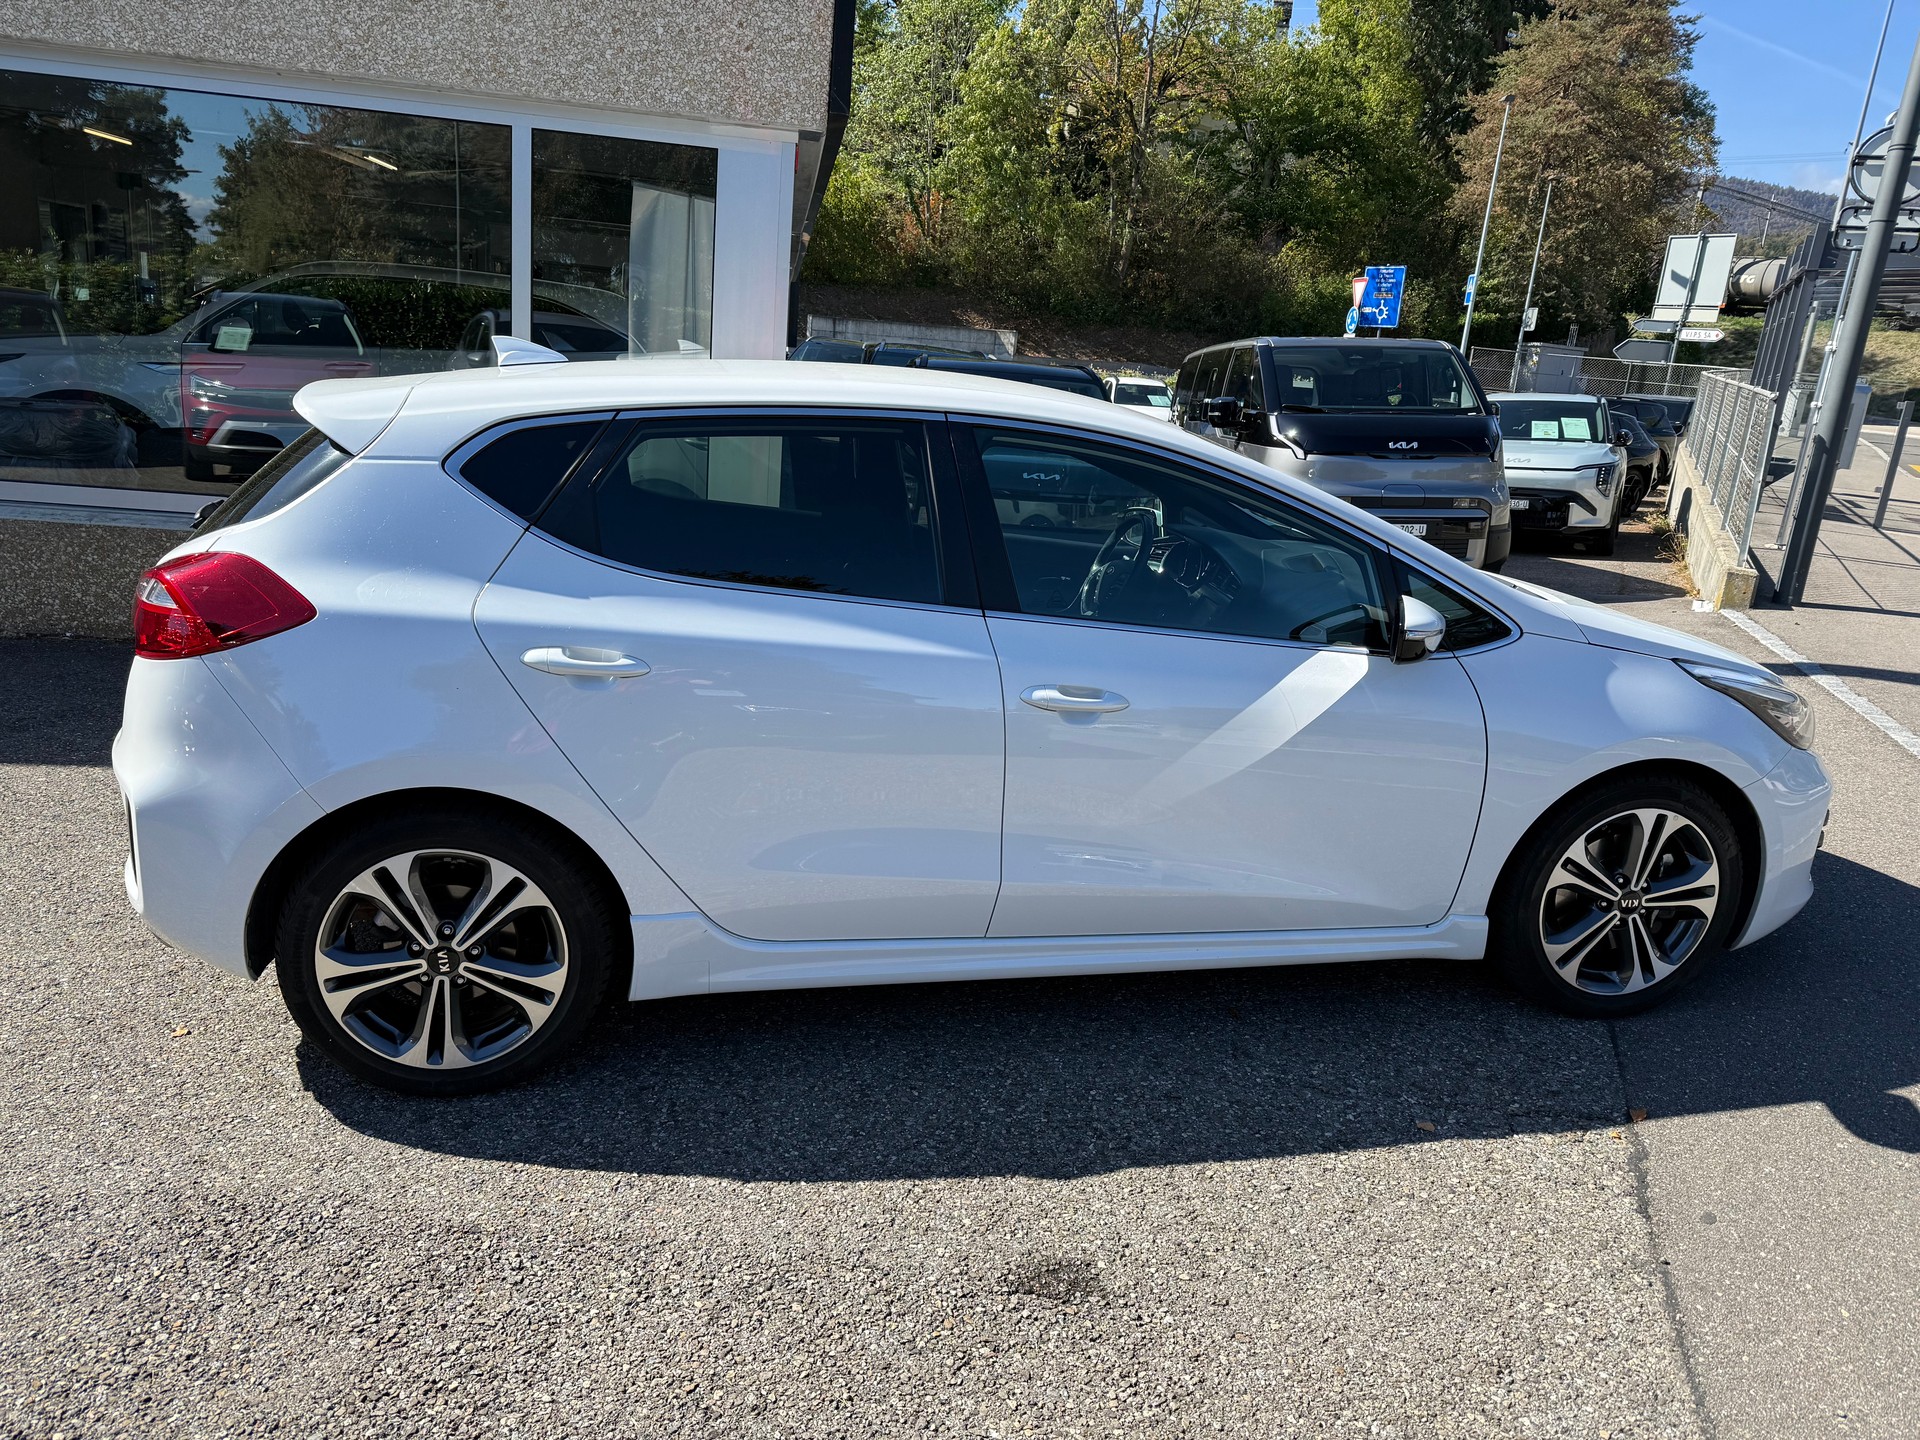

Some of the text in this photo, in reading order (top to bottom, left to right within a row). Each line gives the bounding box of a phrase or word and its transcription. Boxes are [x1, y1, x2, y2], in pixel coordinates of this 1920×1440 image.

[1388, 441, 1418, 449] KIA
[1022, 472, 1061, 481] KIA
[1621, 899, 1639, 908] KIA
[437, 950, 451, 973] KIA
